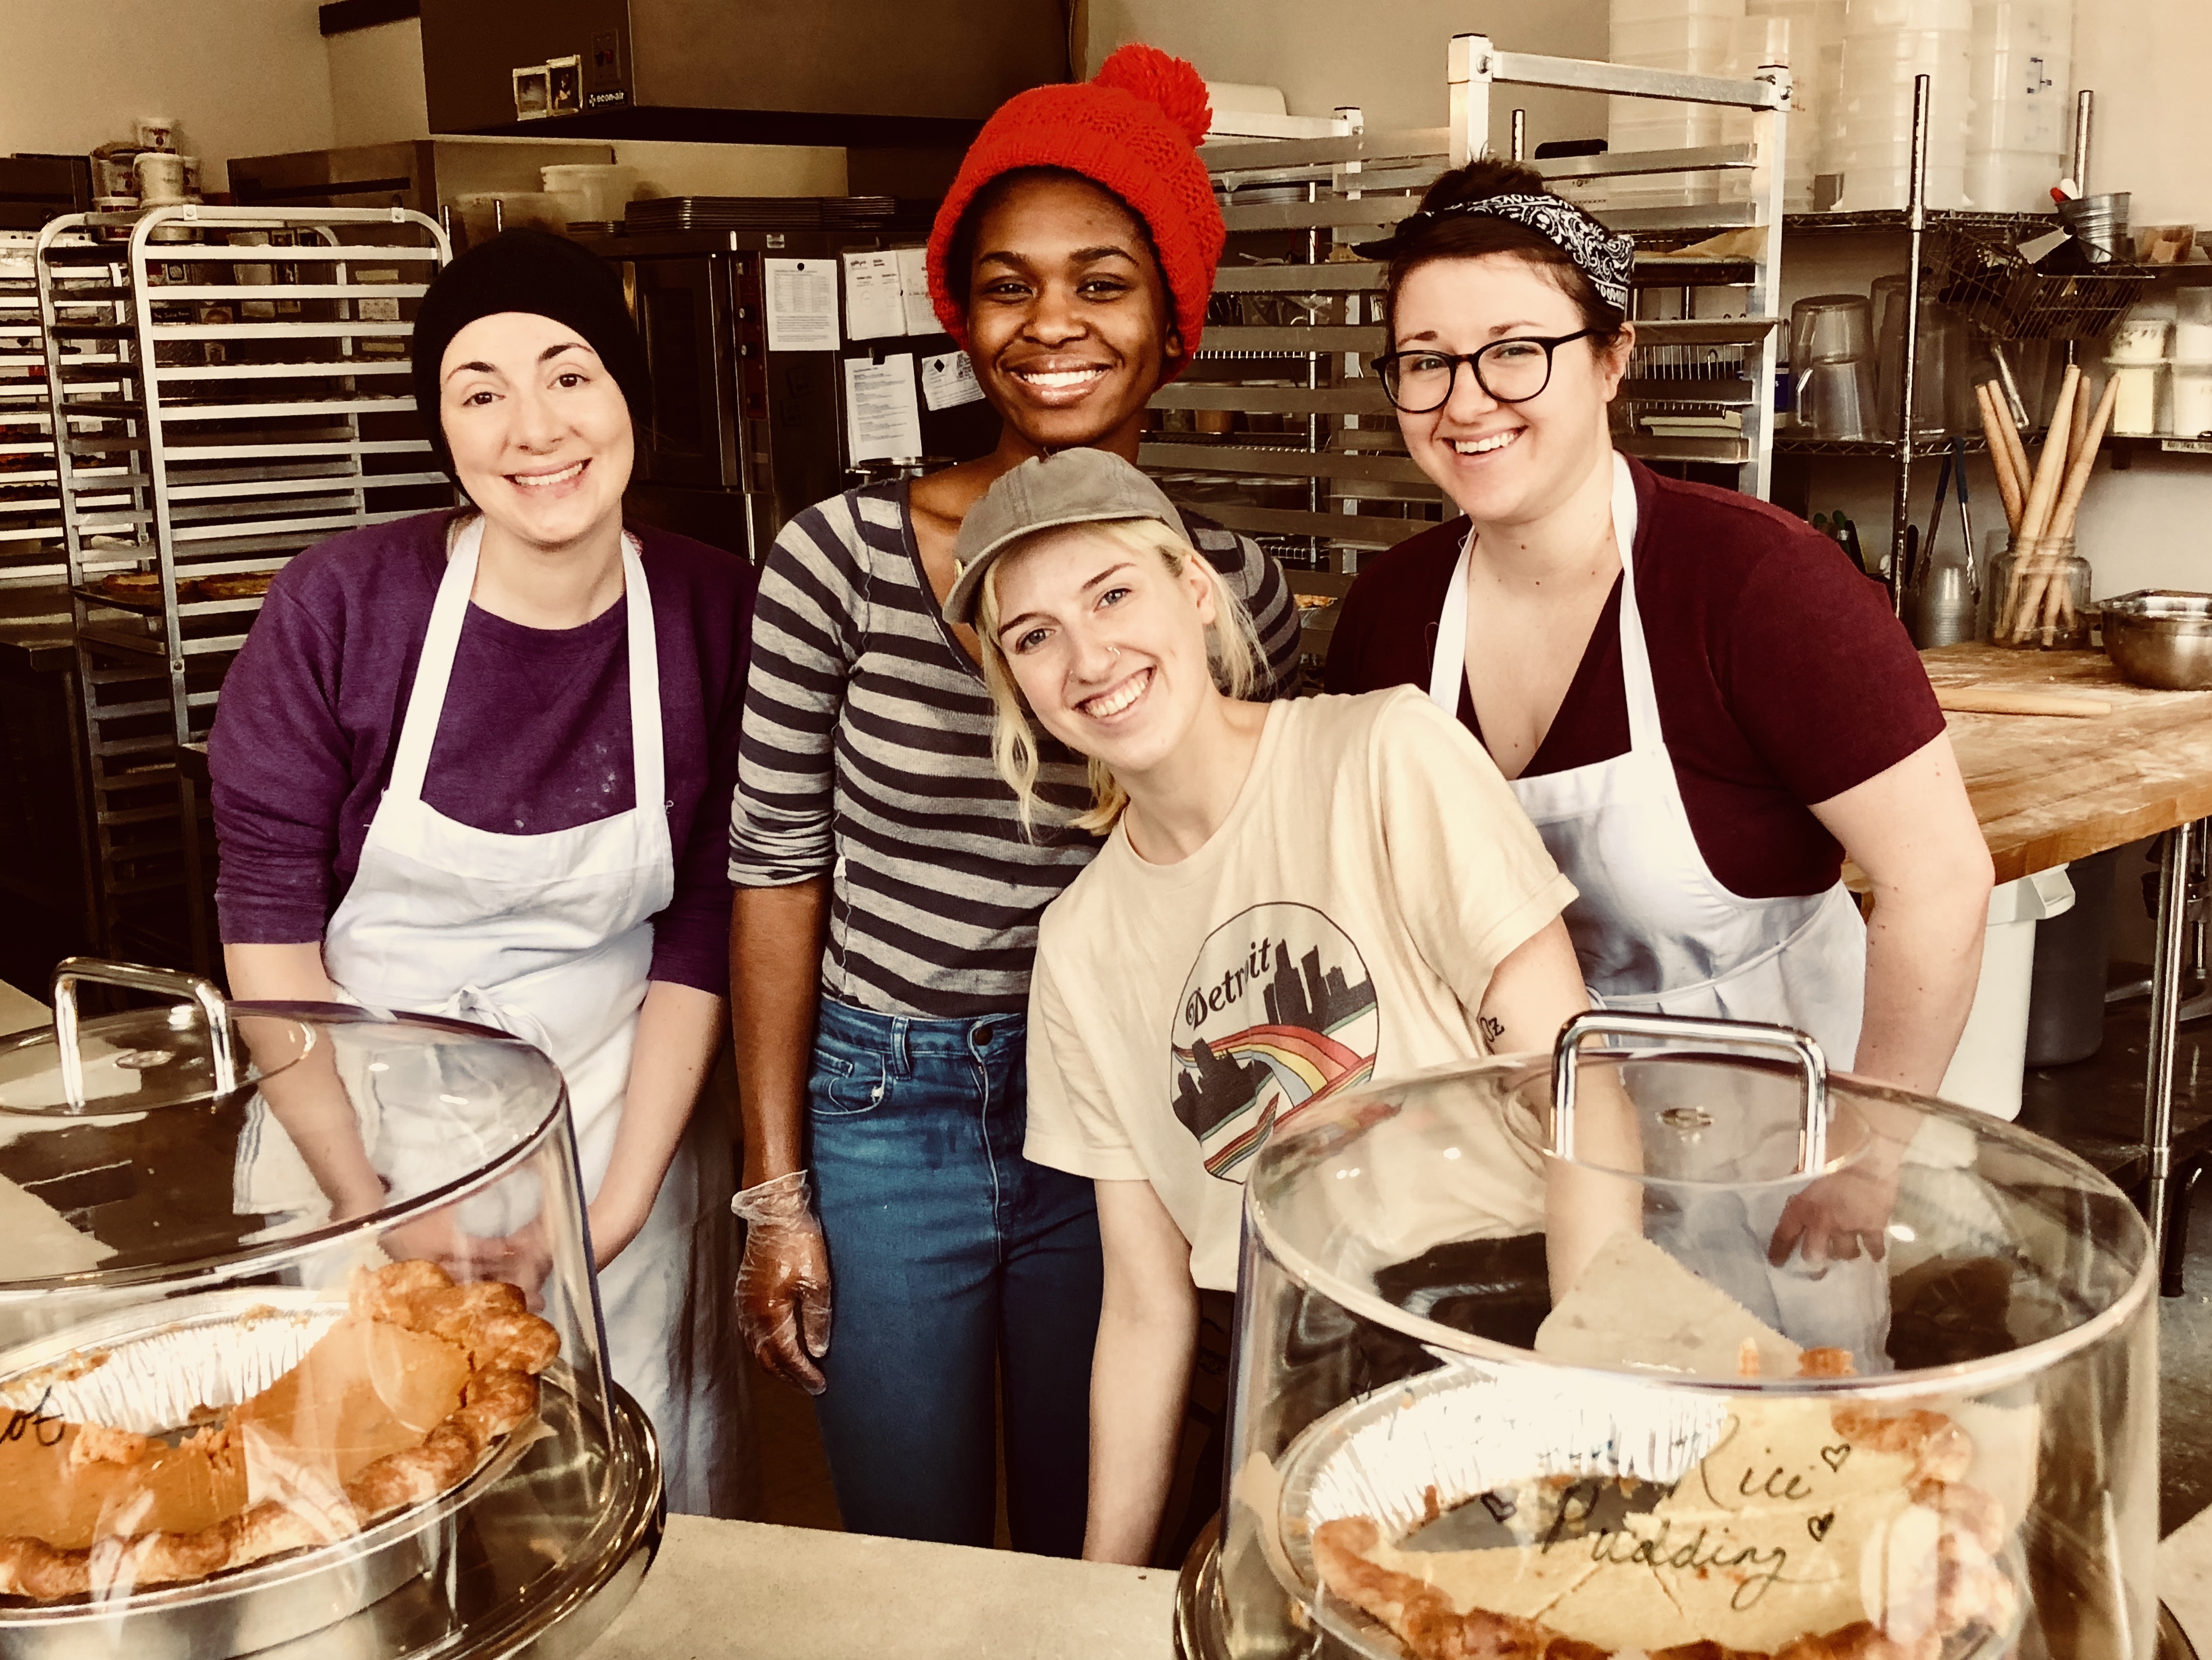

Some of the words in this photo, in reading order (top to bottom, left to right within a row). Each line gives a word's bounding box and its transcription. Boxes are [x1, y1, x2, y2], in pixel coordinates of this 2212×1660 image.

[596, 90, 624, 103] econ-air
[1185, 936, 1272, 1030] Detroit
[1541, 1483, 1825, 1613] Pudding
